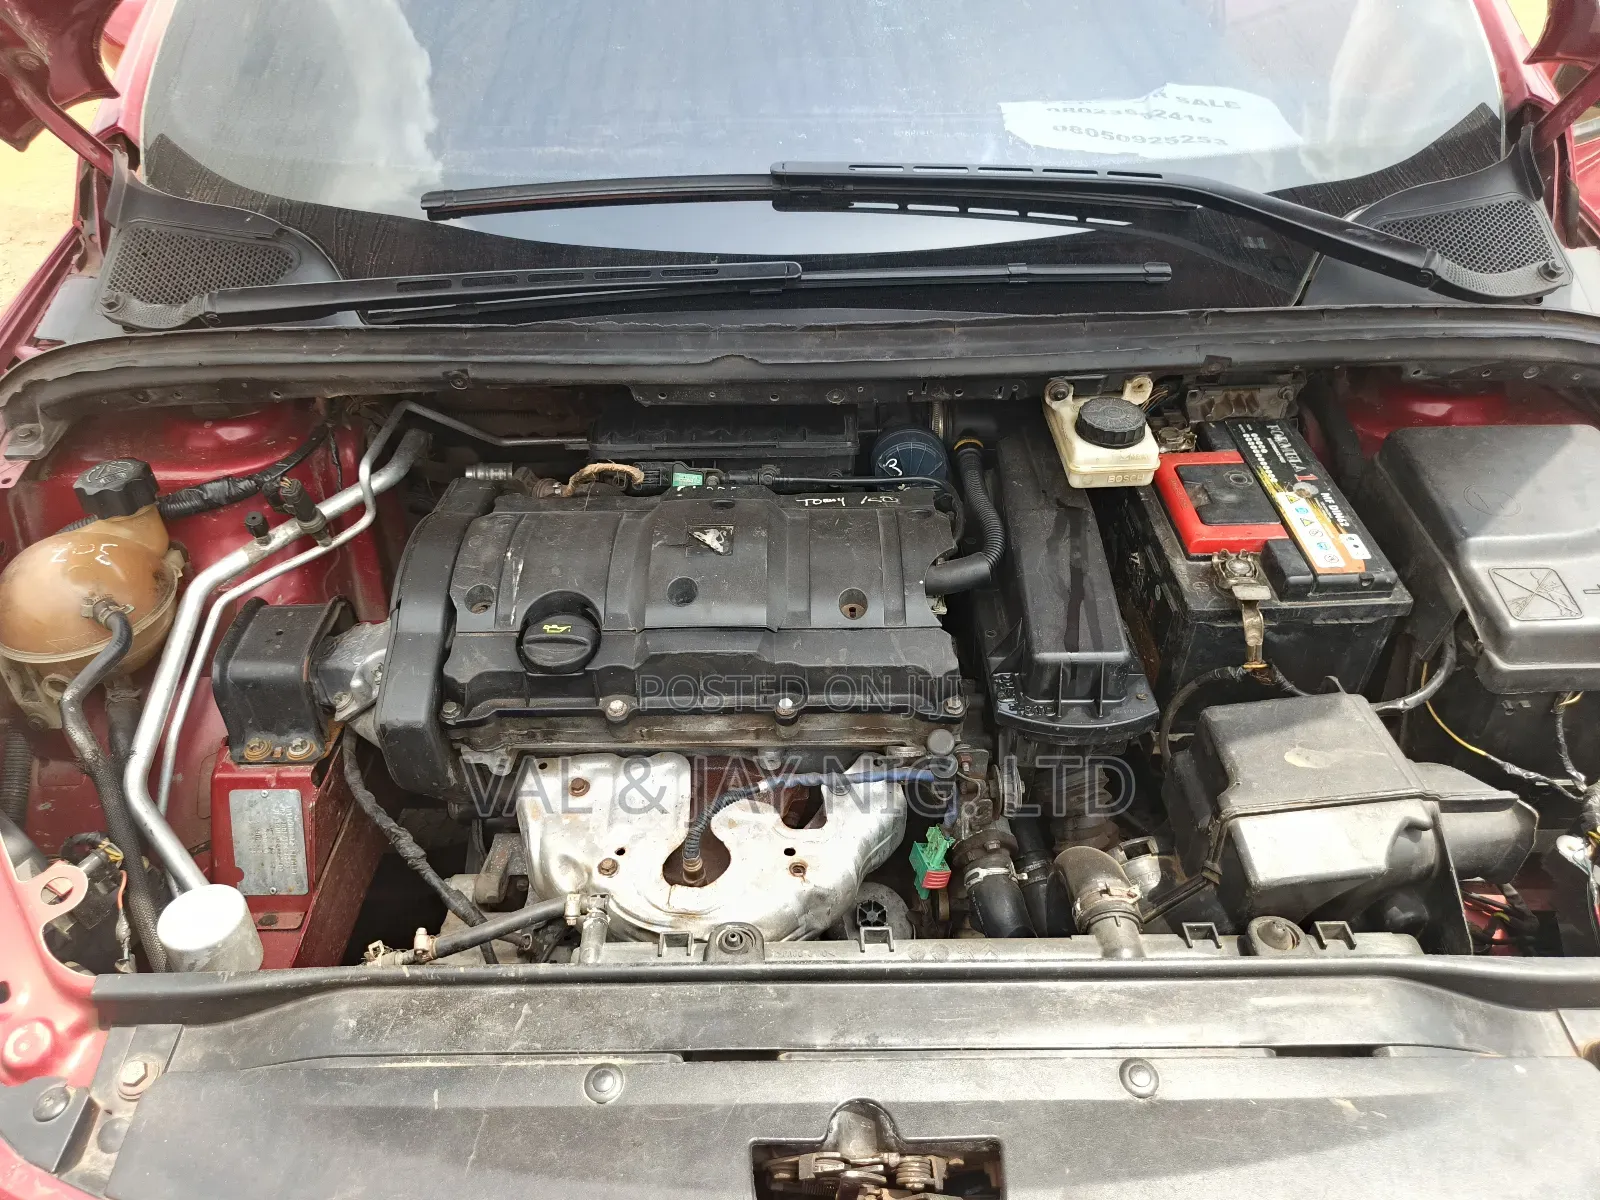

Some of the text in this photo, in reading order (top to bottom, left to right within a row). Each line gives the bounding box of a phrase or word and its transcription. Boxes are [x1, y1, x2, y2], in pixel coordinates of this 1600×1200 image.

[1176, 96, 1241, 109] SALE
[1266, 424, 1307, 473] FORMULA
[1107, 474, 1145, 483] BOSCH
